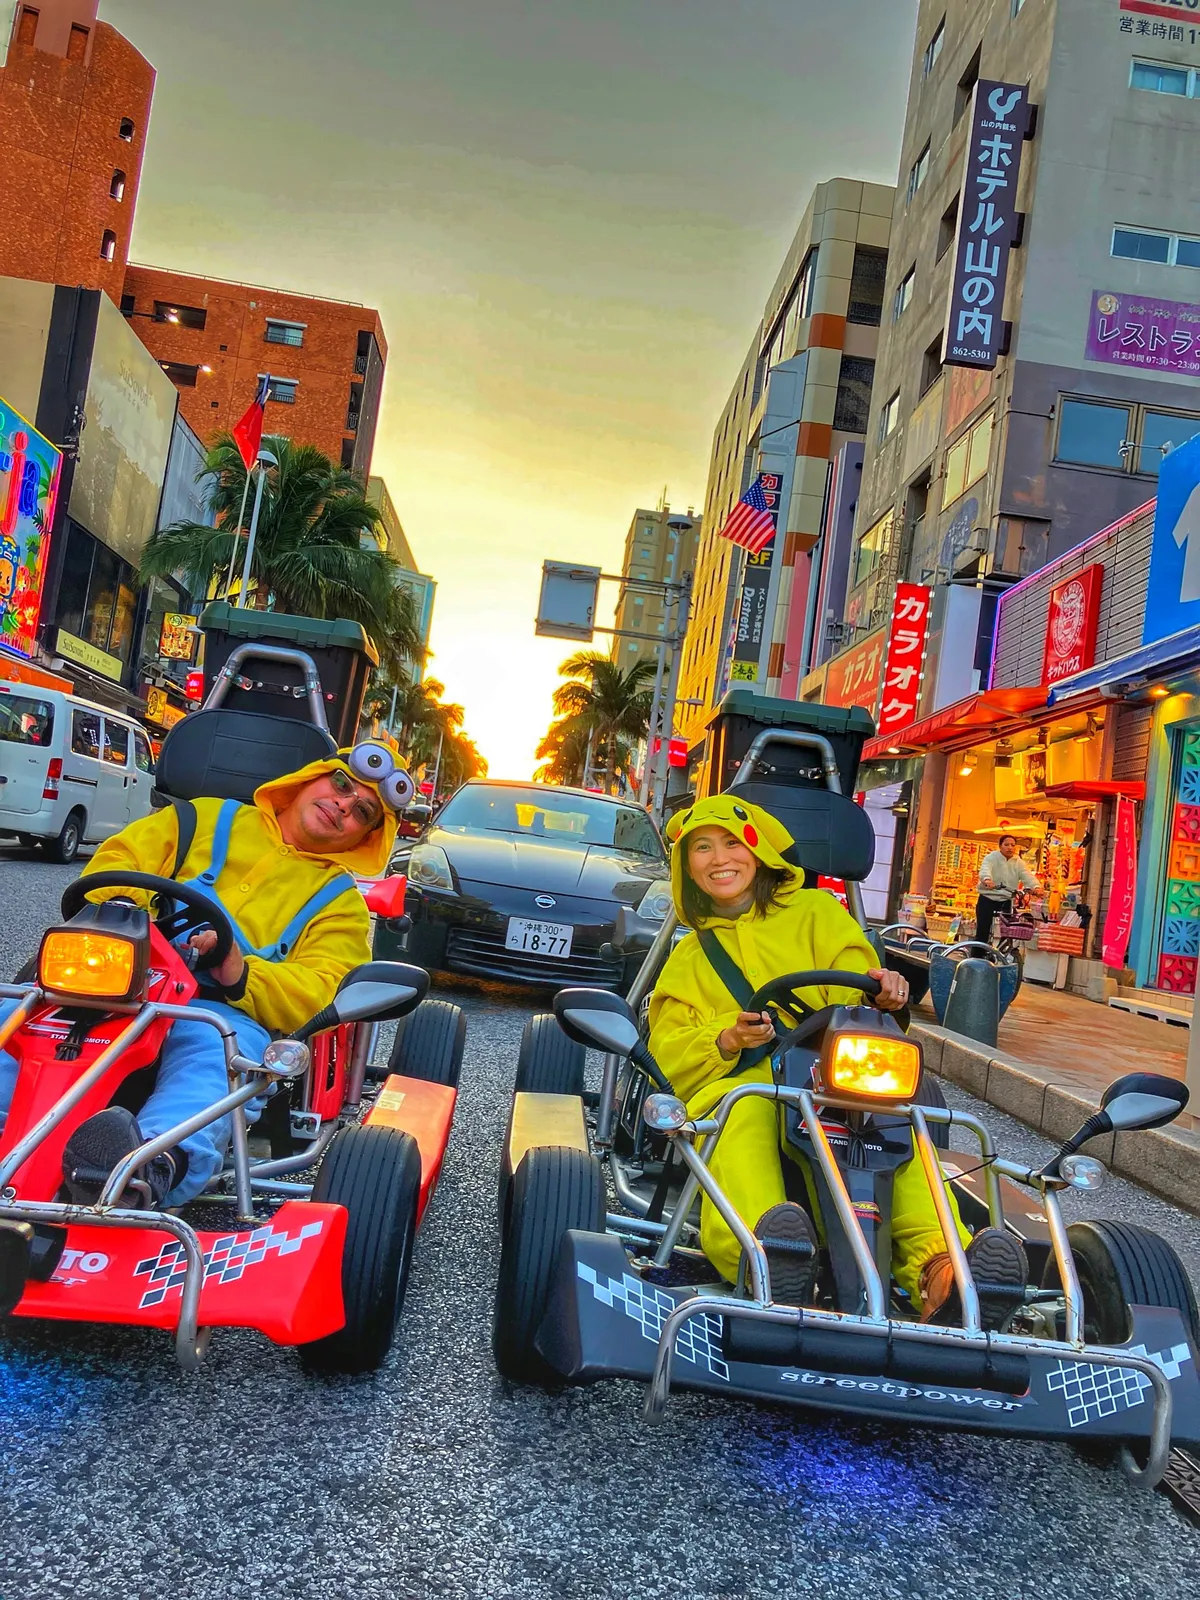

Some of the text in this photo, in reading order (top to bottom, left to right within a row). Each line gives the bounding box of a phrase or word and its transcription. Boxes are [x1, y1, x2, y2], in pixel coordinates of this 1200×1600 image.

[1119, 16, 1184, 42] 営業時間
[957, 134, 1012, 345] ホテル山の内
[953, 346, 990, 360] 862-5301
[1112, 350, 1145, 363] 営業時間
[749, 551, 771, 565] 3F
[841, 642, 884, 698] カラオ
[883, 596, 925, 722] カラオケ
[511, 933, 568, 955] ら 18-77
[780, 1370, 1023, 1412] streetpower
